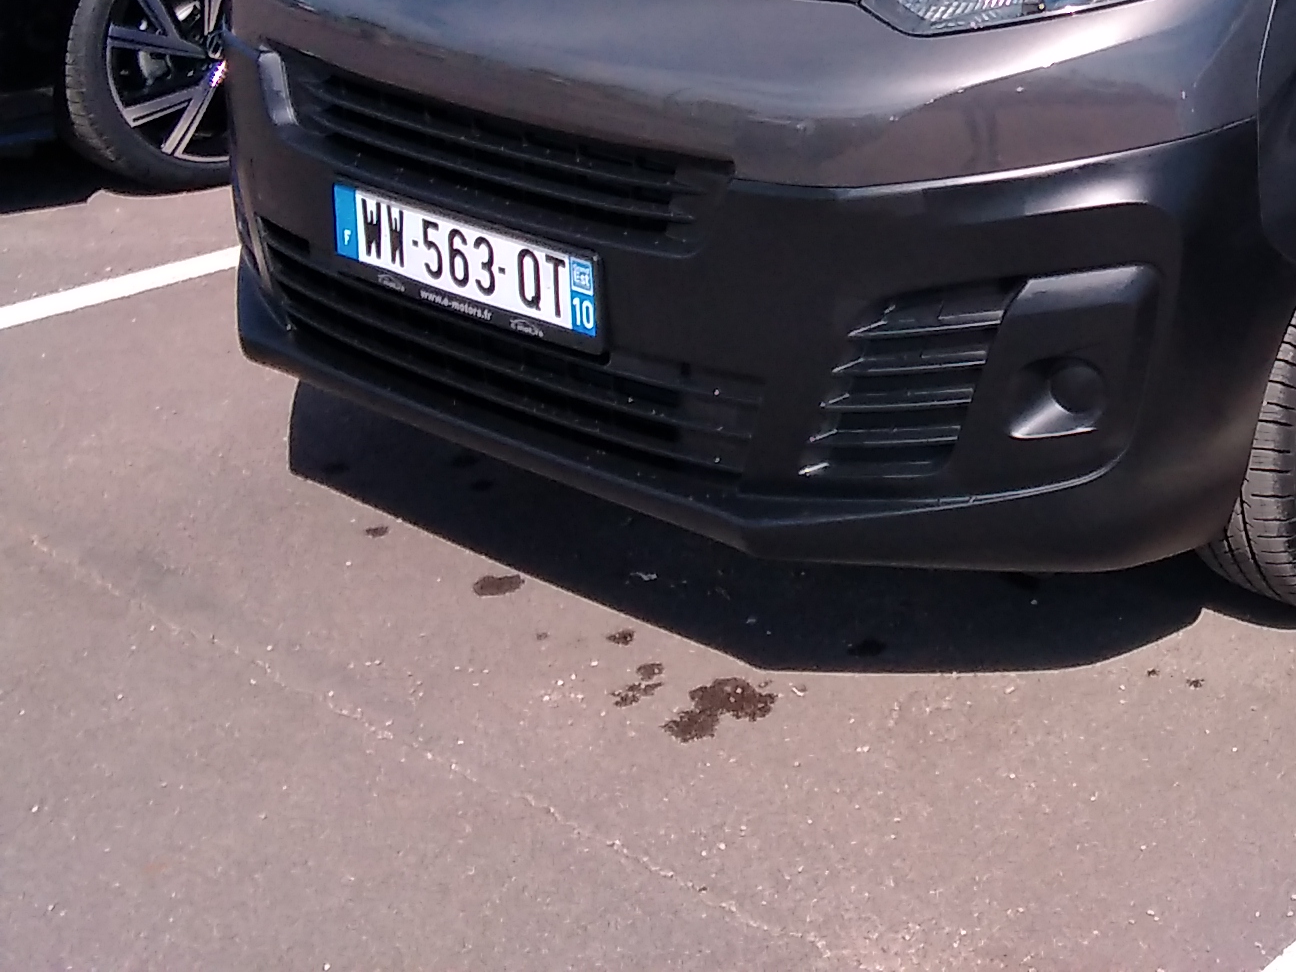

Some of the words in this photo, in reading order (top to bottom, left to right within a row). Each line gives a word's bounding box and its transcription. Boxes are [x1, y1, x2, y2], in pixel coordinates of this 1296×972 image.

[344, 229, 352, 245] F
[361, 197, 566, 319] WW-563-QT
[419, 290, 493, 321] www.e-motors.fr
[572, 297, 594, 330] 10
